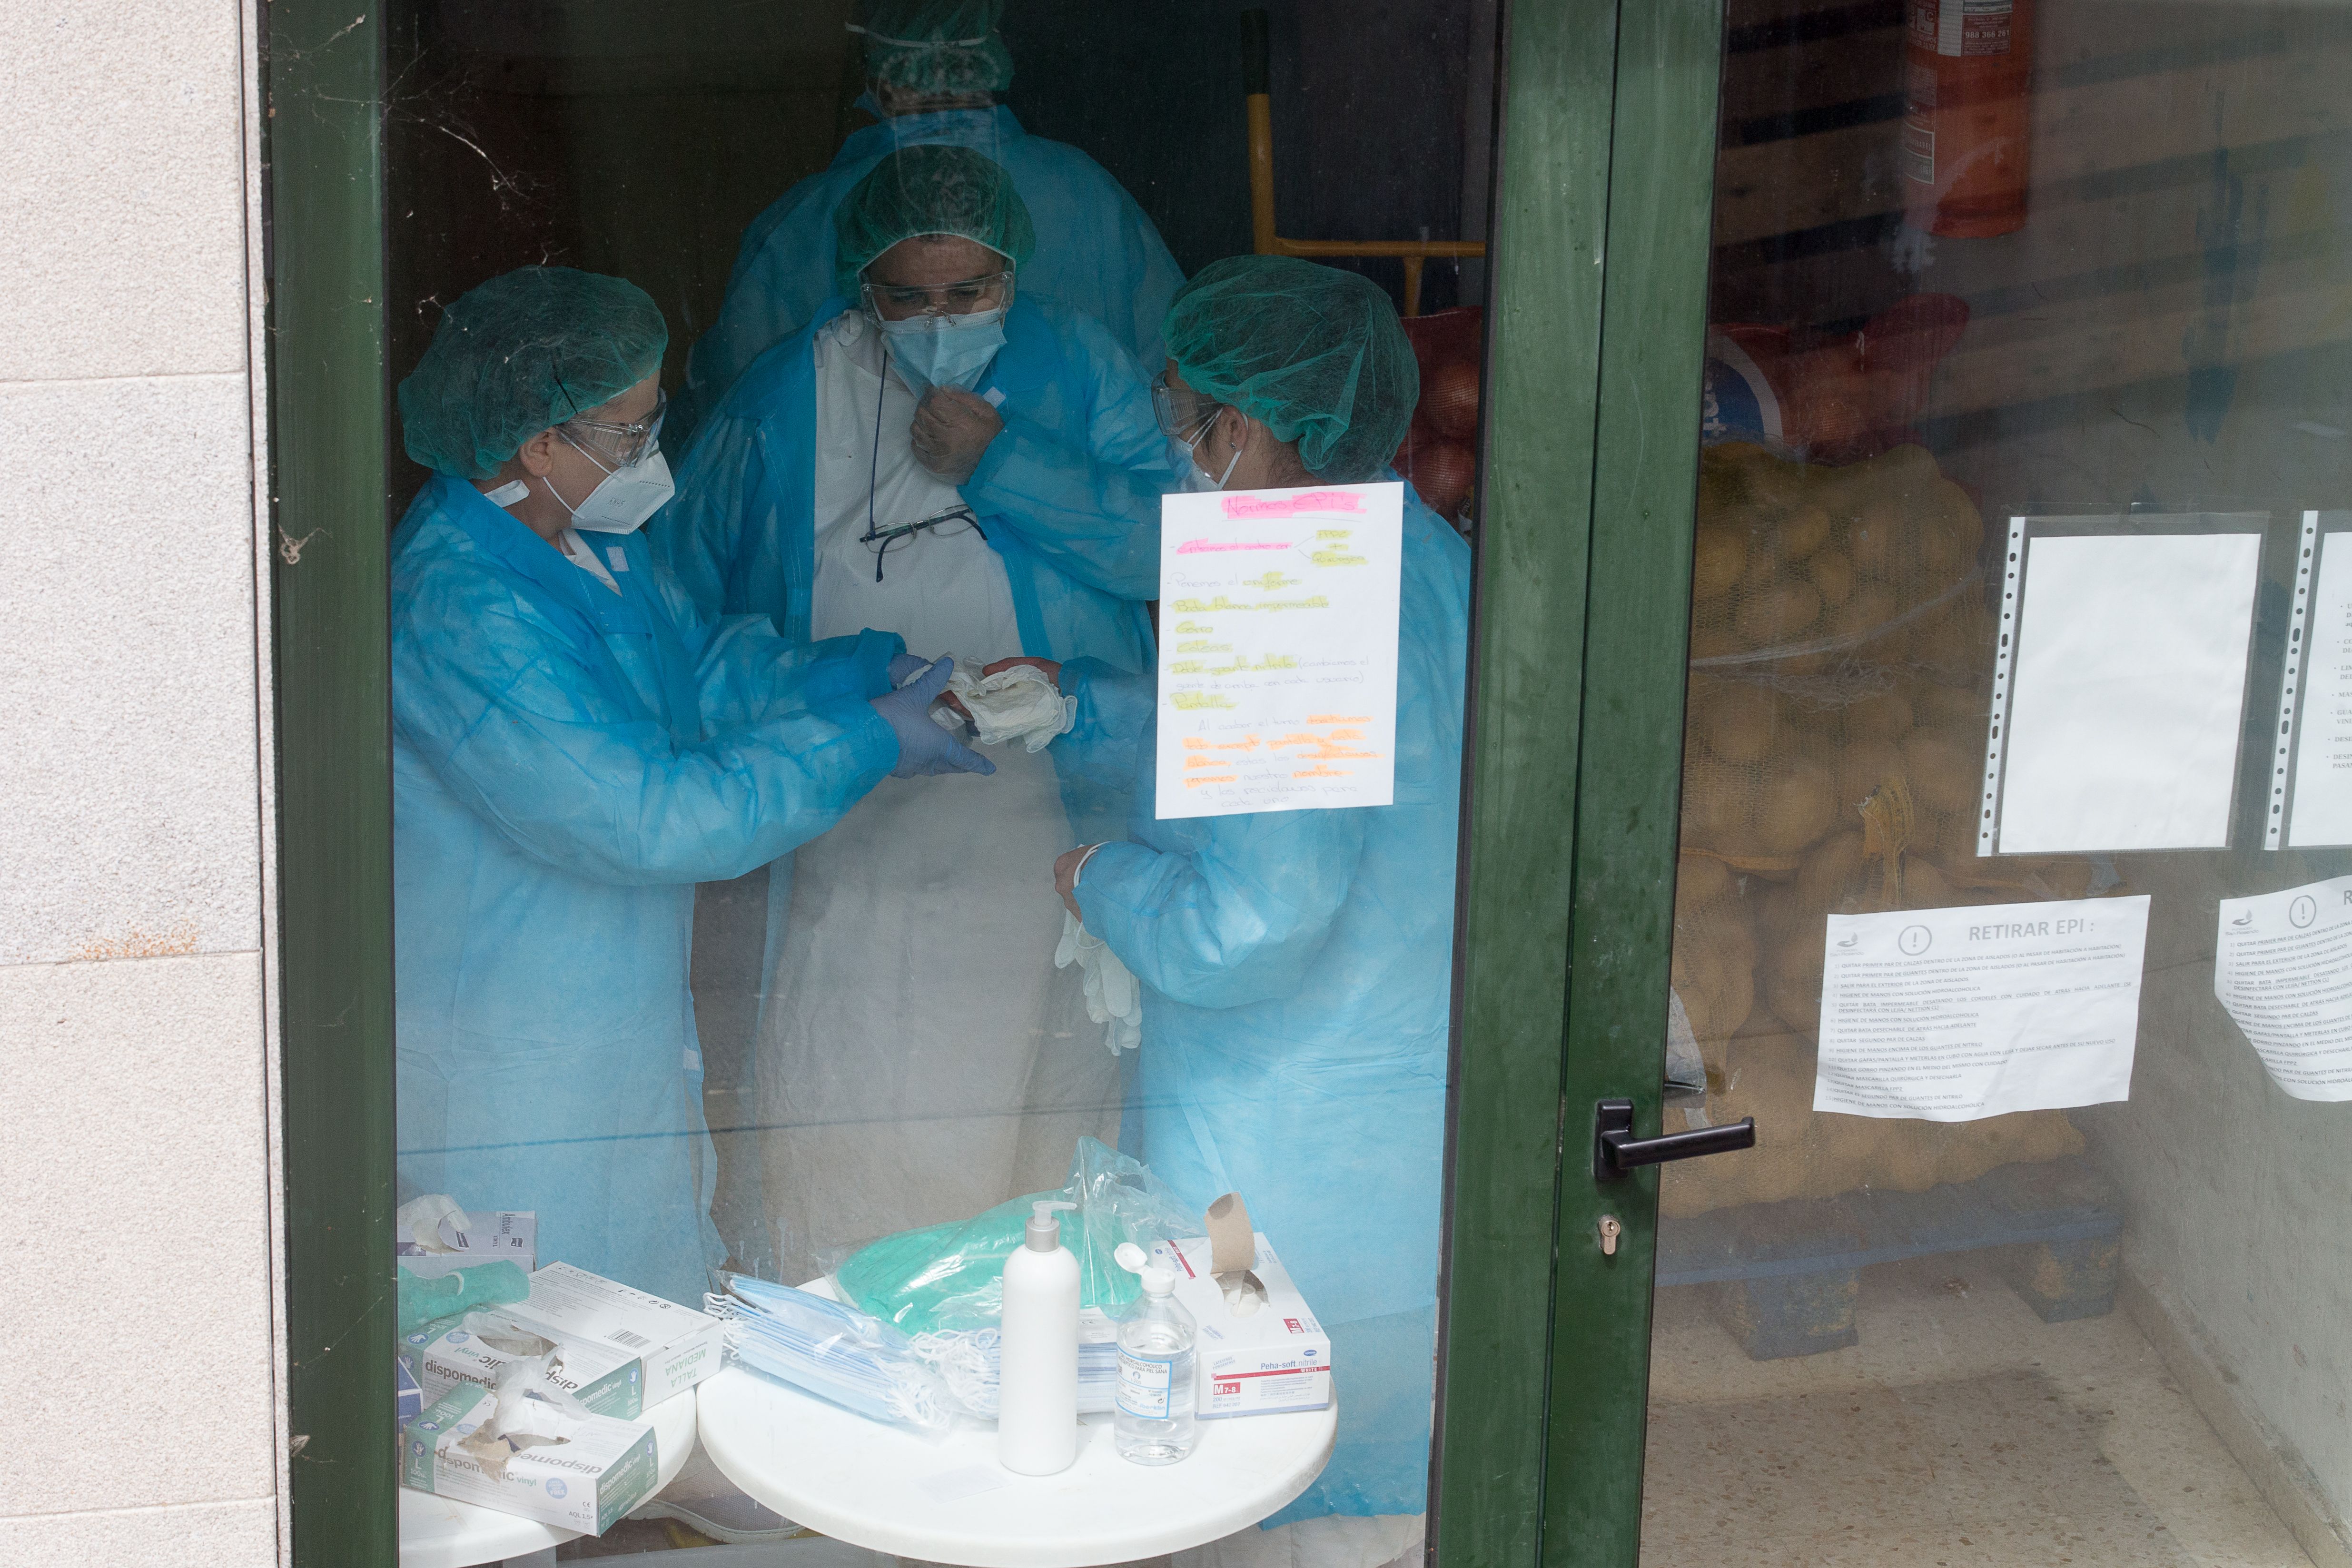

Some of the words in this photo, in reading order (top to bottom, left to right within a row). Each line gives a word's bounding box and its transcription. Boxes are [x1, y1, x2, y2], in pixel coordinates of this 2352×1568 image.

[1227, 497, 1286, 516] Normas
[1228, 573, 1237, 586] el
[1174, 601, 1207, 612] Bata
[1969, 921, 2049, 940] RETIRAR
[2056, 918, 2084, 935] EPI
[502, 1213, 516, 1235] Ambulex
[665, 1349, 706, 1376] MEDIANA
[1260, 1361, 1296, 1370] Peha-soft
[670, 1367, 697, 1388] TALLA
[579, 1383, 612, 1406] spomedic
[631, 1386, 636, 1396] L
[1214, 1384, 1224, 1395] M
[517, 1477, 537, 1487] vinyl
[600, 1460, 633, 1494] dispomedic
